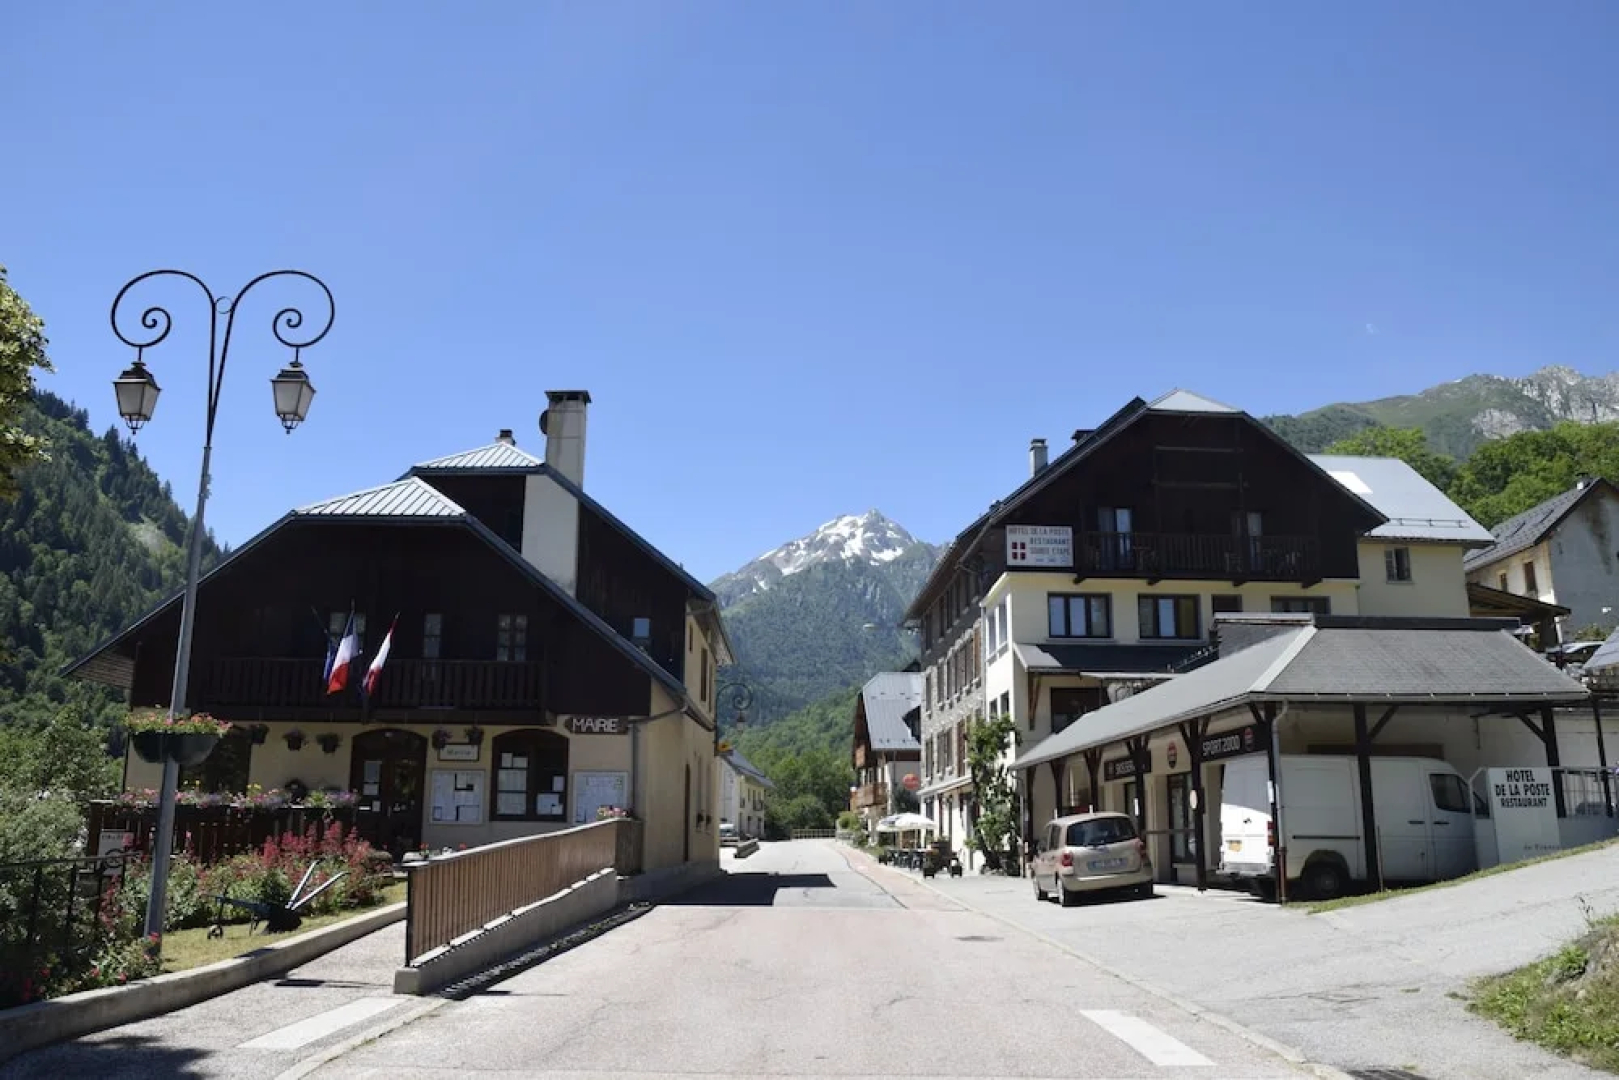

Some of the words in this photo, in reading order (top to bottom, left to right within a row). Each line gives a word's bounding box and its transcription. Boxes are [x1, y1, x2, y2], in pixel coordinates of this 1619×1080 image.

[573, 718, 618, 733] MAIRIE
[1202, 737, 1222, 757] SPORT
[1222, 734, 1241, 753] 2000
[1506, 769, 1535, 782] HOTEL
[1495, 784, 1507, 796] DE
[1509, 784, 1521, 796] LA
[1523, 783, 1551, 796] POSTE
[1501, 797, 1547, 808] RESTAURANT
